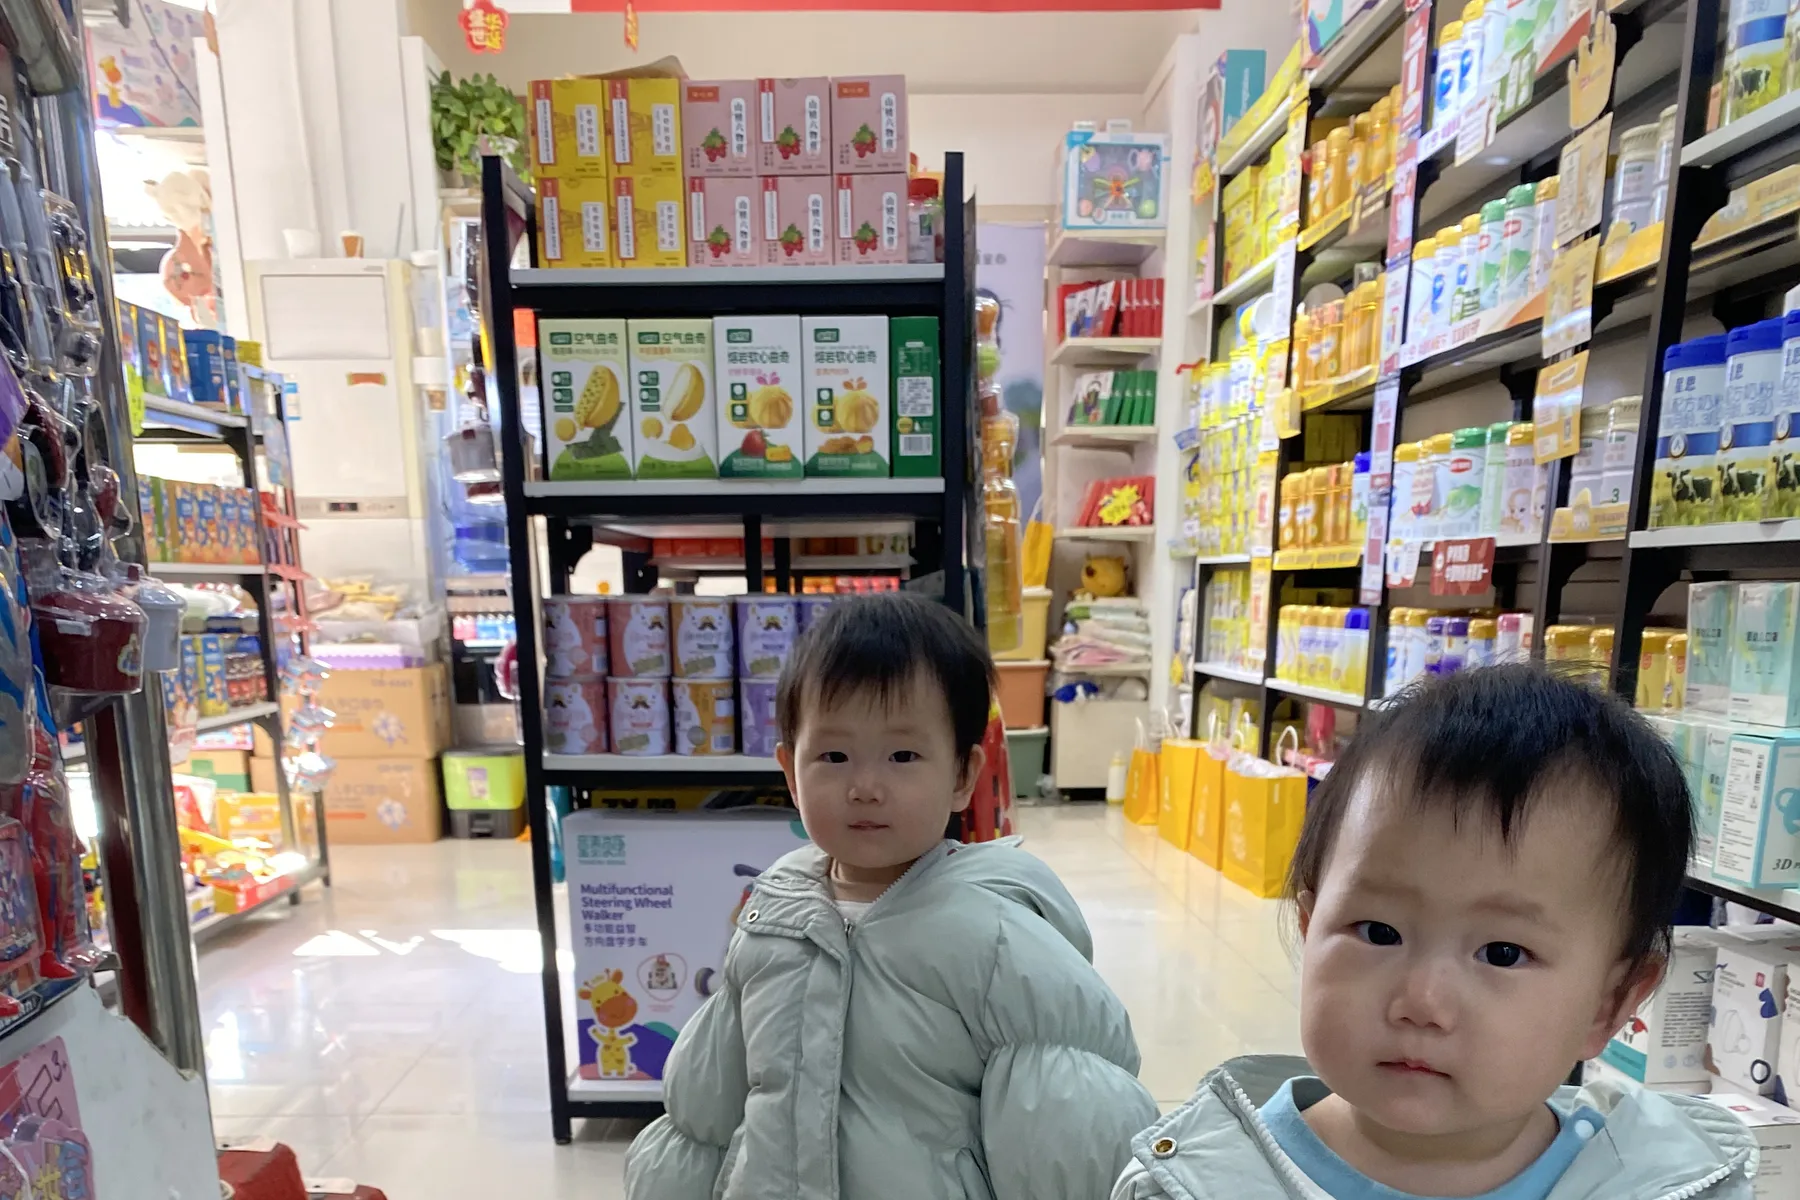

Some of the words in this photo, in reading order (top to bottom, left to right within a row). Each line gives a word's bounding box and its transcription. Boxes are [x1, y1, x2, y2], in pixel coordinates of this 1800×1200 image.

[1772, 858, 1793, 871] 3D
[580, 882, 674, 896] Multifunctional
[581, 897, 632, 911] Steering
[634, 897, 673, 909] Wheel
[581, 909, 625, 921] Walker
